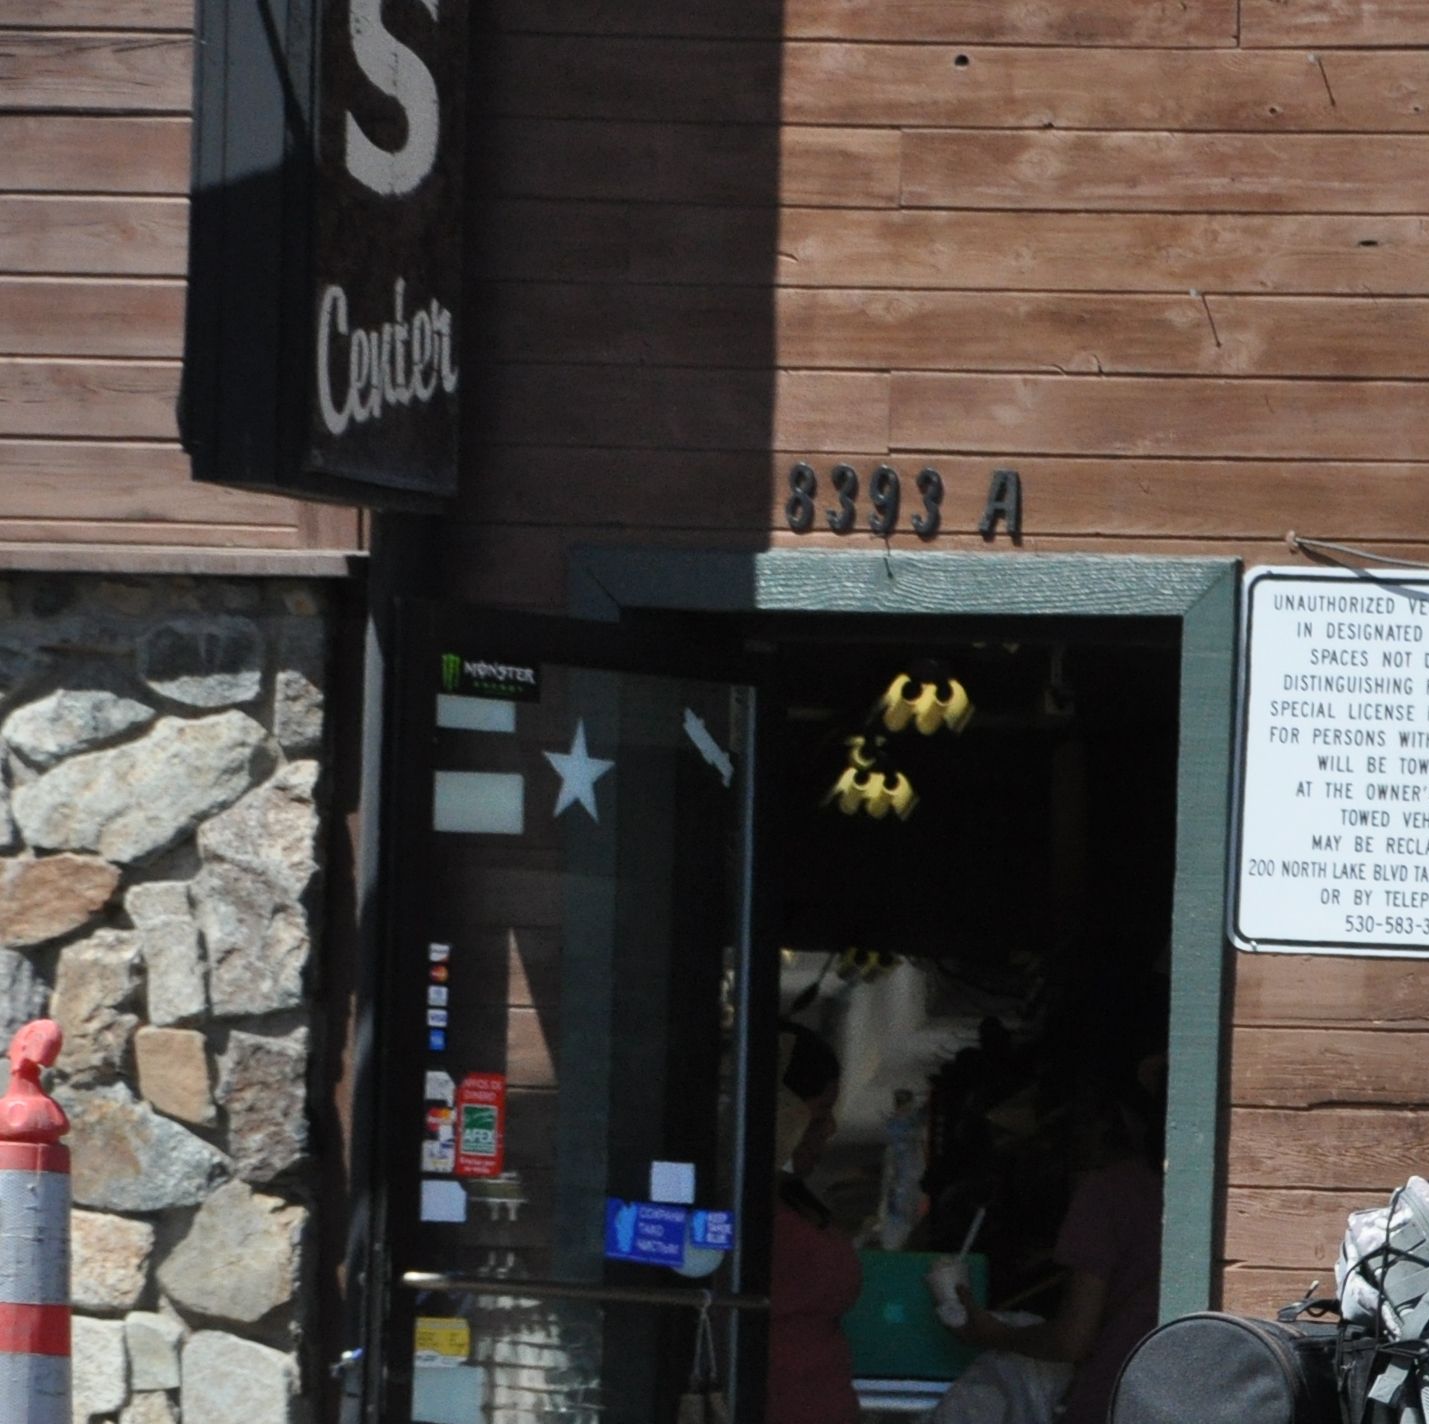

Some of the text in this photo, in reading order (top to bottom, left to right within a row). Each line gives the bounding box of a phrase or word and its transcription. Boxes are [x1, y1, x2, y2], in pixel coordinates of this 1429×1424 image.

[317, 275, 459, 437] Center
[785, 462, 1022, 545] 8393 A
[1274, 595, 1394, 614] UNAUTHORIZED
[1298, 622, 1312, 638] IN
[1327, 623, 1423, 641] DESIGNATED
[1310, 650, 1368, 666] SPACES
[1382, 652, 1412, 668] NOT
[1284, 675, 1413, 695] DISTINGUISHING
[1271, 702, 1335, 718] SPECIAL
[1350, 704, 1414, 721] LICENSE
[1270, 727, 1300, 743] FOR
[1313, 729, 1385, 747] PERSONS
[1318, 755, 1354, 772] WILL
[1367, 757, 1386, 774] BE
[1296, 782, 1312, 798] AT
[1325, 782, 1353, 799] THE
[1341, 809, 1390, 827] TOWED
[1312, 835, 1341, 852] MAY
[1354, 837, 1374, 853] BE
[1249, 859, 1274, 876] 200
[1282, 861, 1327, 878] NORTH
[1332, 863, 1366, 880] LAKE
[1373, 864, 1408, 882] BLVD
[1320, 888, 1340, 906] OR
[1354, 890, 1372, 906] BY
